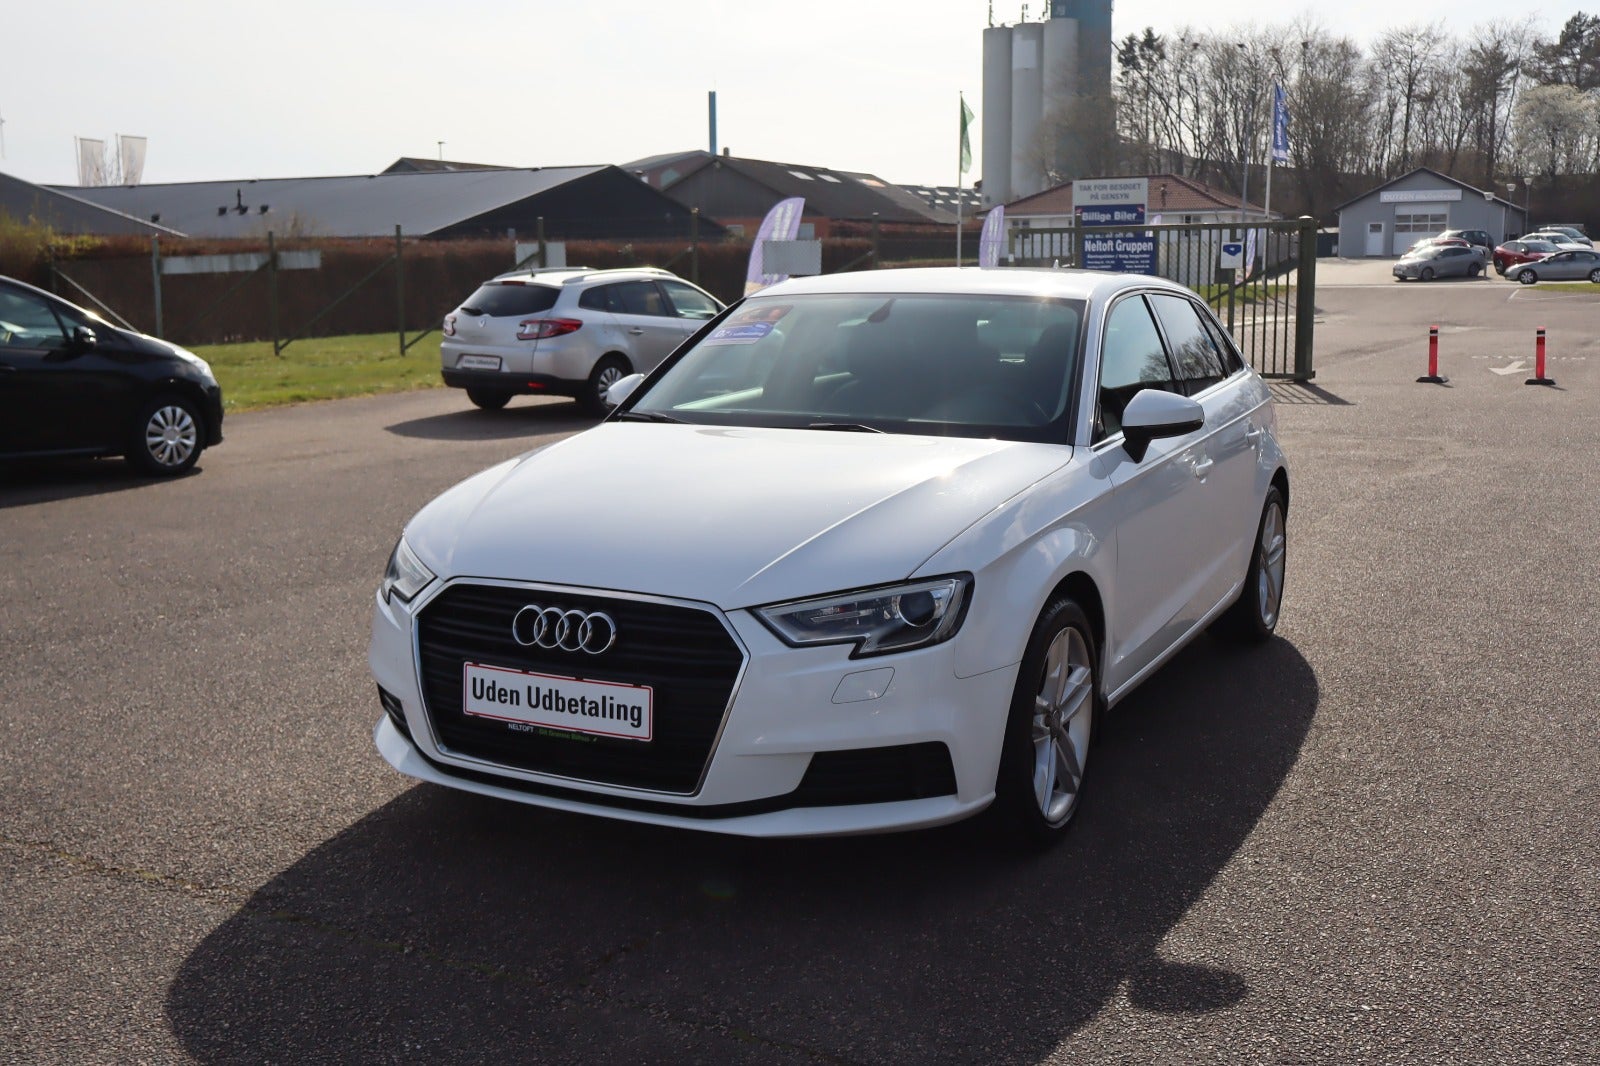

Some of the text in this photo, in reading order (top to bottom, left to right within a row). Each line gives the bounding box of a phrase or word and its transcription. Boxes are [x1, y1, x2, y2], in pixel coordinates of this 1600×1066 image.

[1109, 183, 1142, 191] BESØGET
[1082, 211, 1138, 222] Billige Biler
[1084, 239, 1154, 253] Neltoft Gruppen
[472, 677, 642, 728] Uden Udbetaling
[508, 723, 534, 732] NELTOFT
